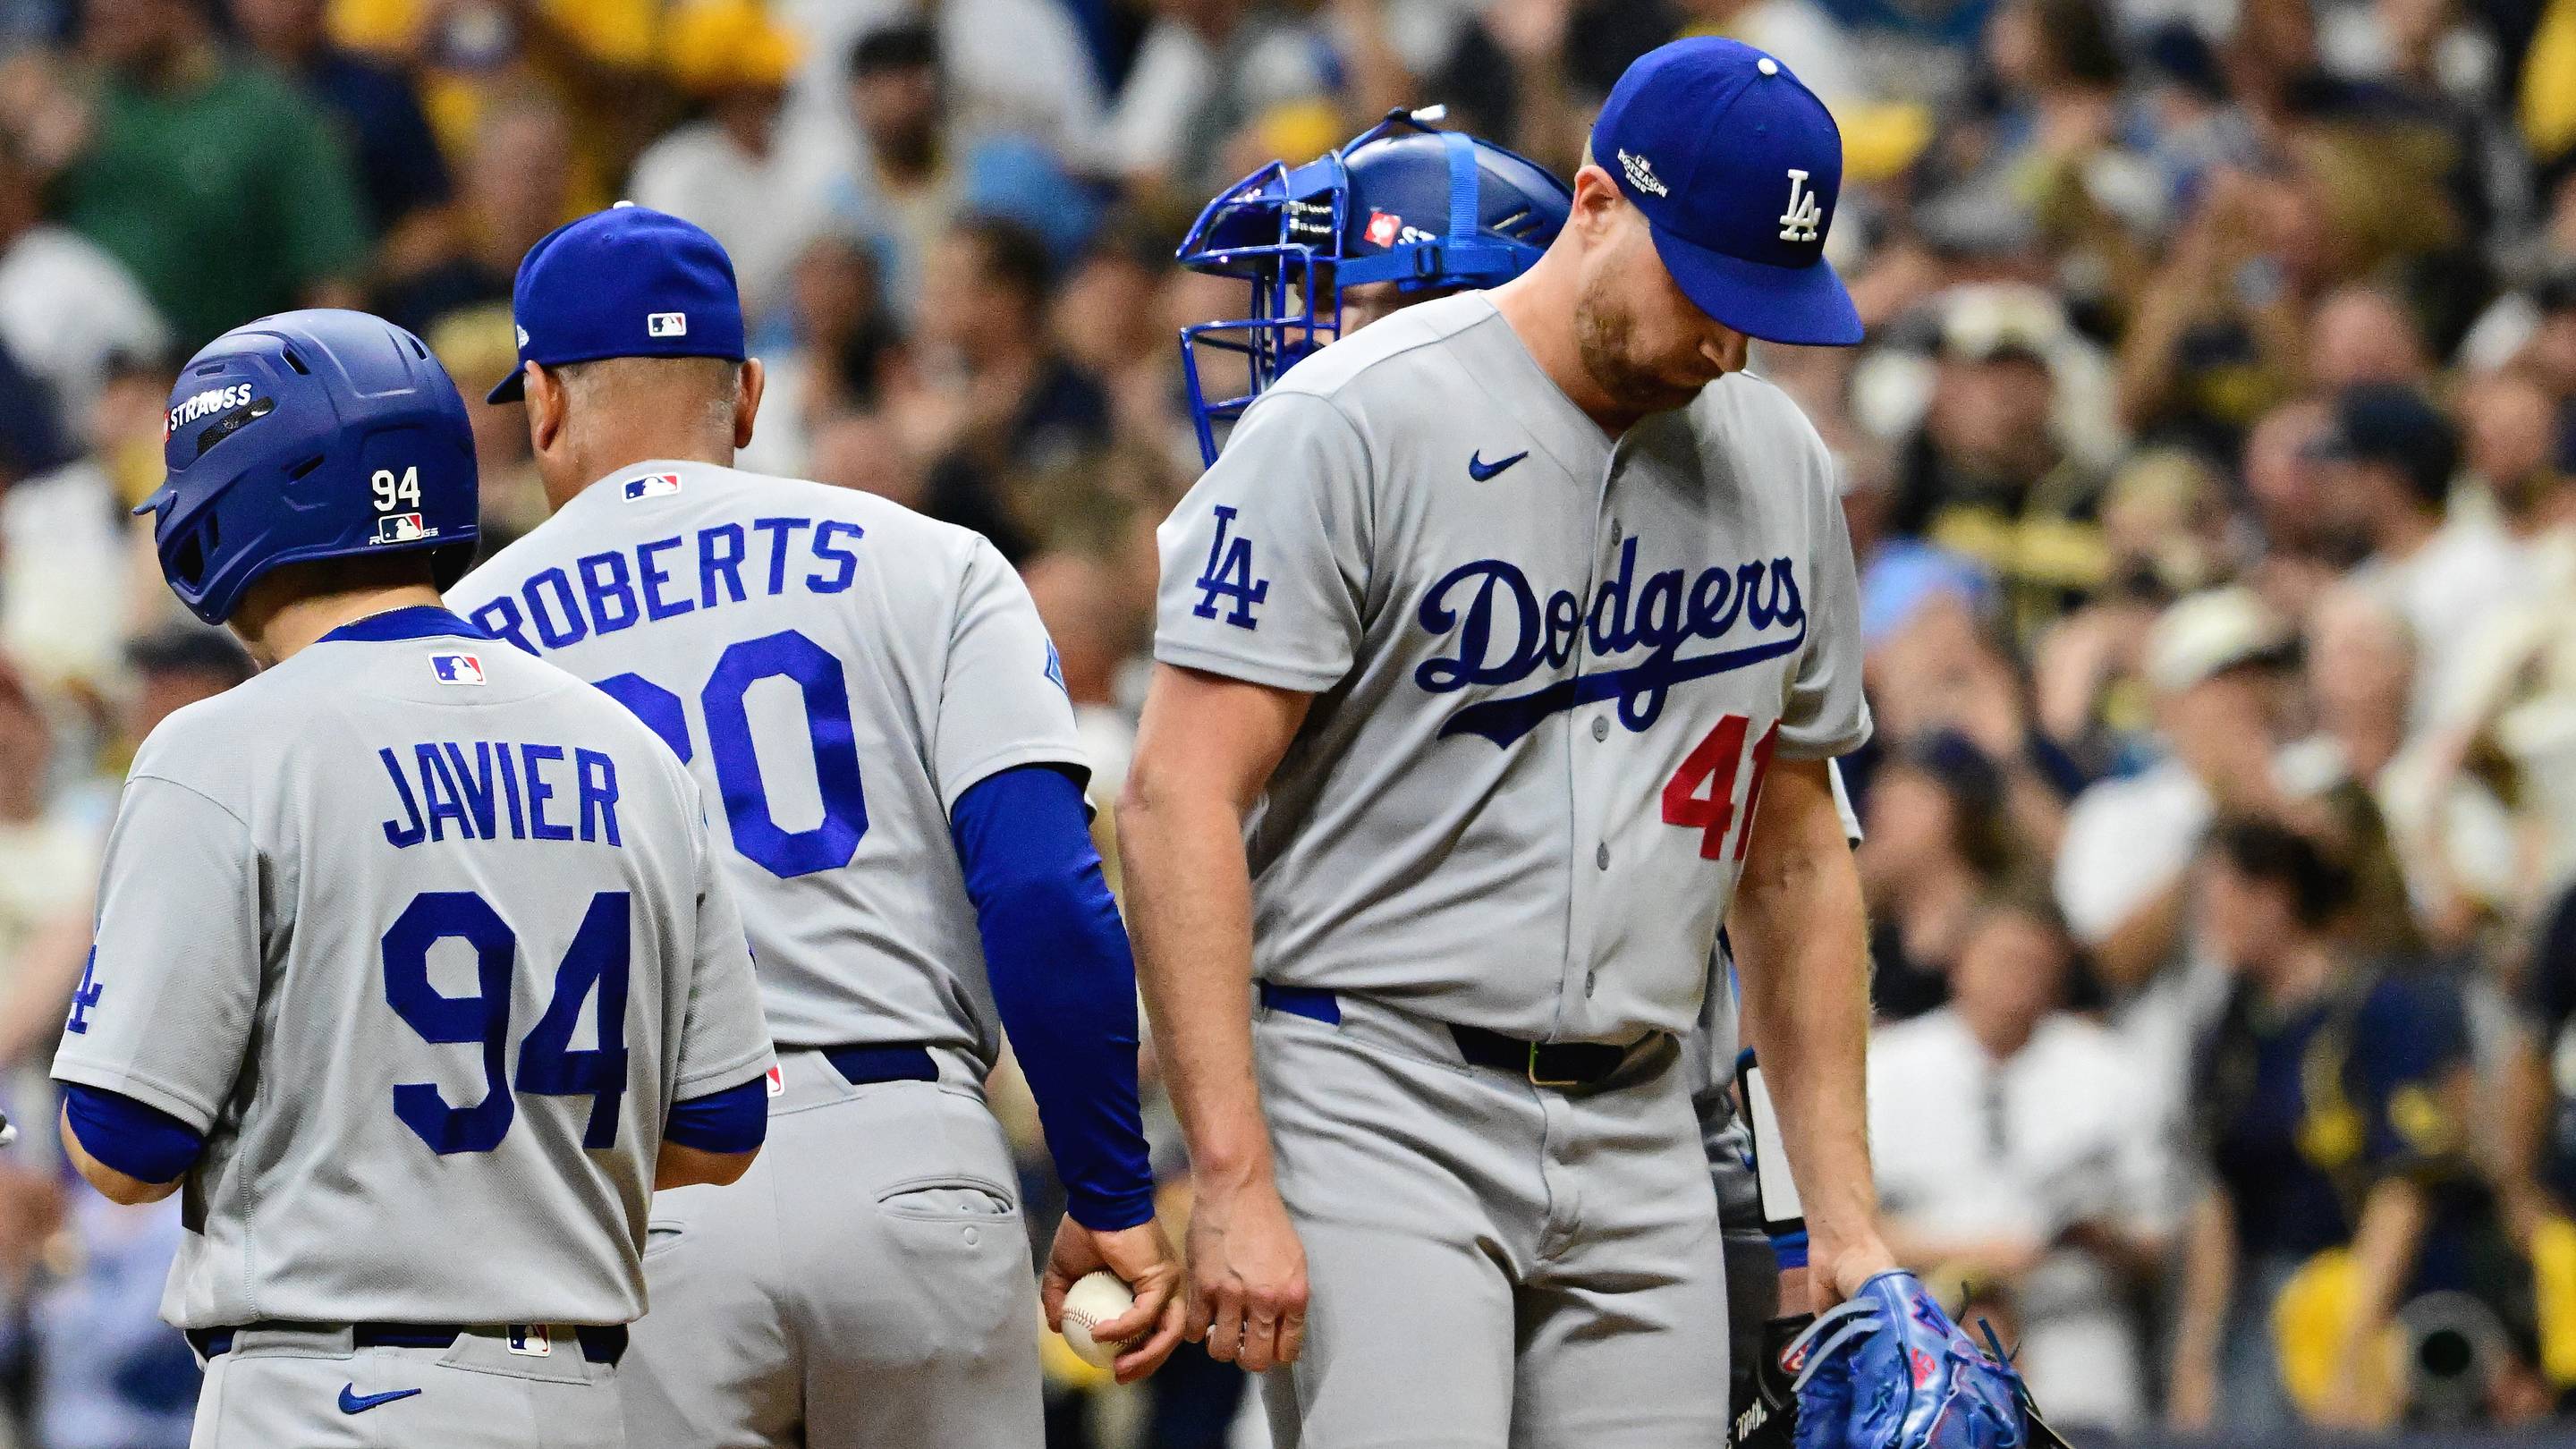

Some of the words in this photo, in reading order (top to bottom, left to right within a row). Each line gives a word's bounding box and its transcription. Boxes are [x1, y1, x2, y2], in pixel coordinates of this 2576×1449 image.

[1778, 168, 1822, 242] LA
[170, 383, 252, 431] STRAUSS
[371, 466, 421, 512] 94
[468, 517, 865, 657] ROBERTS
[1192, 504, 1269, 631] LA
[1414, 537, 1806, 733] Dodgers
[378, 741, 623, 848] JAVIER
[381, 891, 631, 1155] 94
